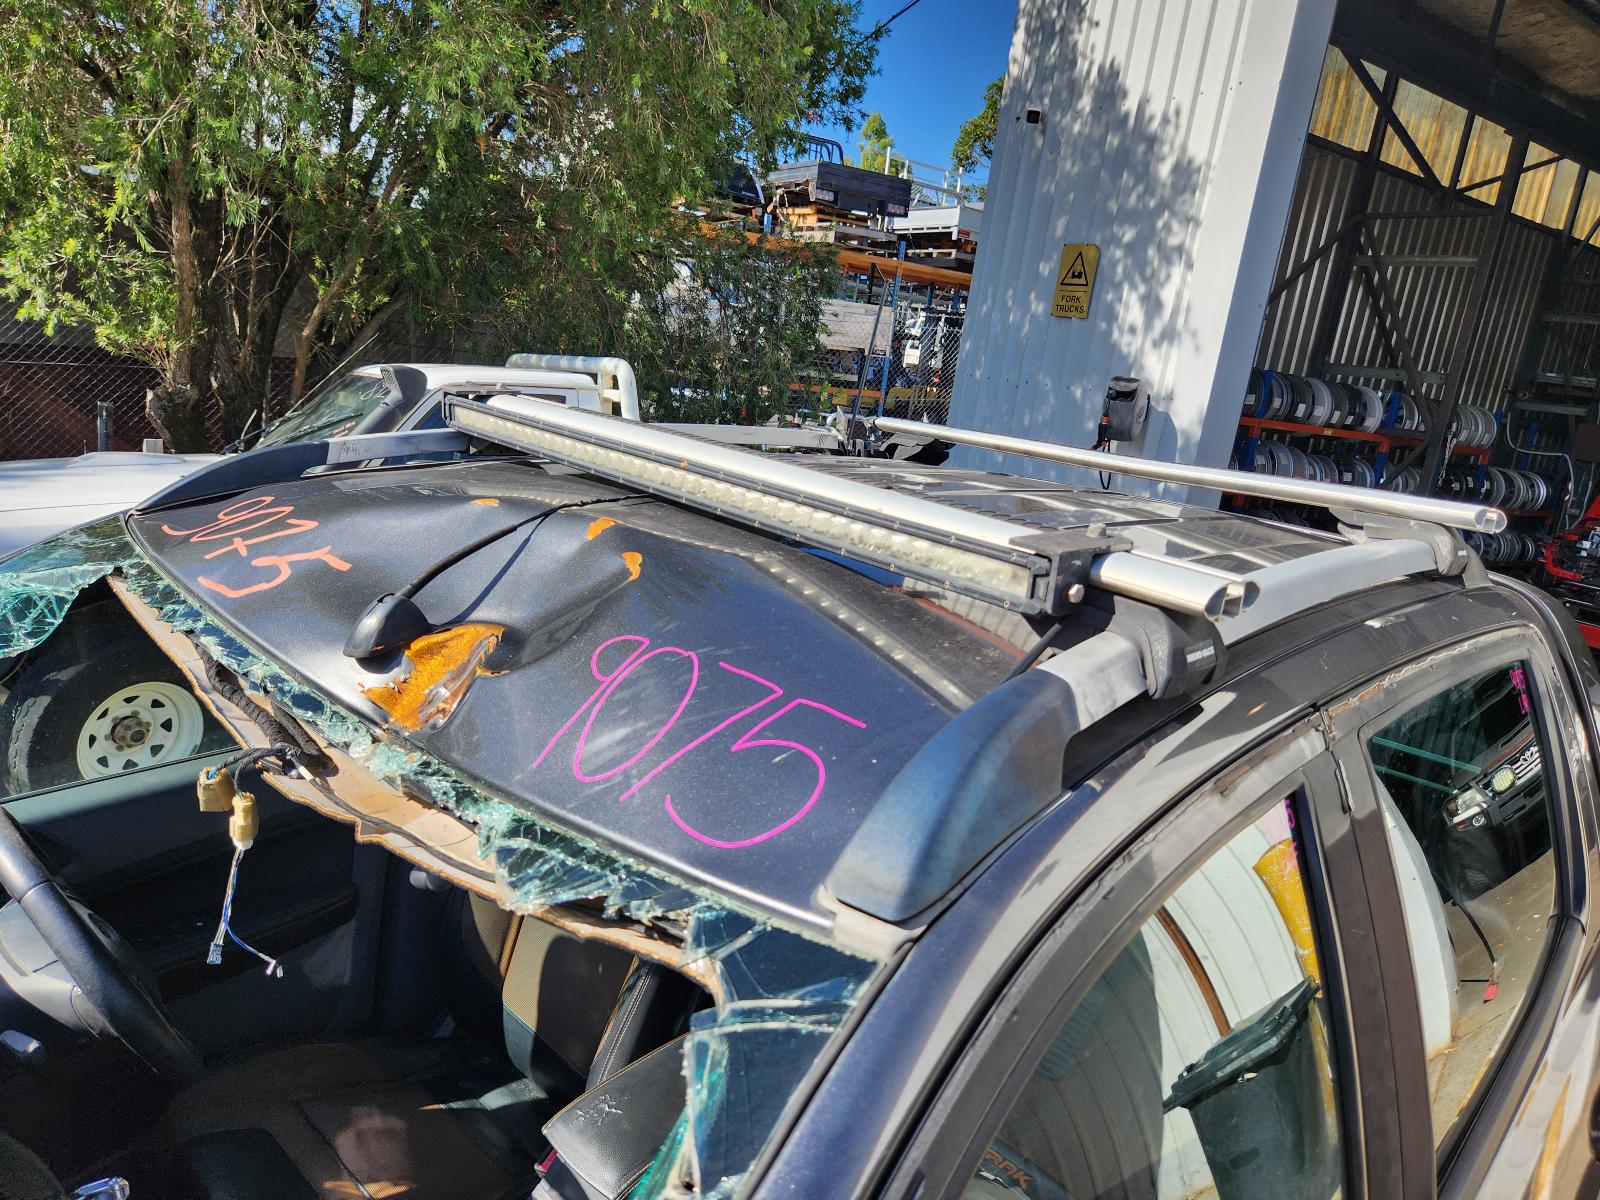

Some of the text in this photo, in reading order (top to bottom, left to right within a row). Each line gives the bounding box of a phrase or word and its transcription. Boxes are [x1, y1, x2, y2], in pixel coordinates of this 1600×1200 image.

[1060, 295, 1081, 303] FORK
[1055, 304, 1085, 313] TRUCKS
[533, 634, 867, 848] 9075
